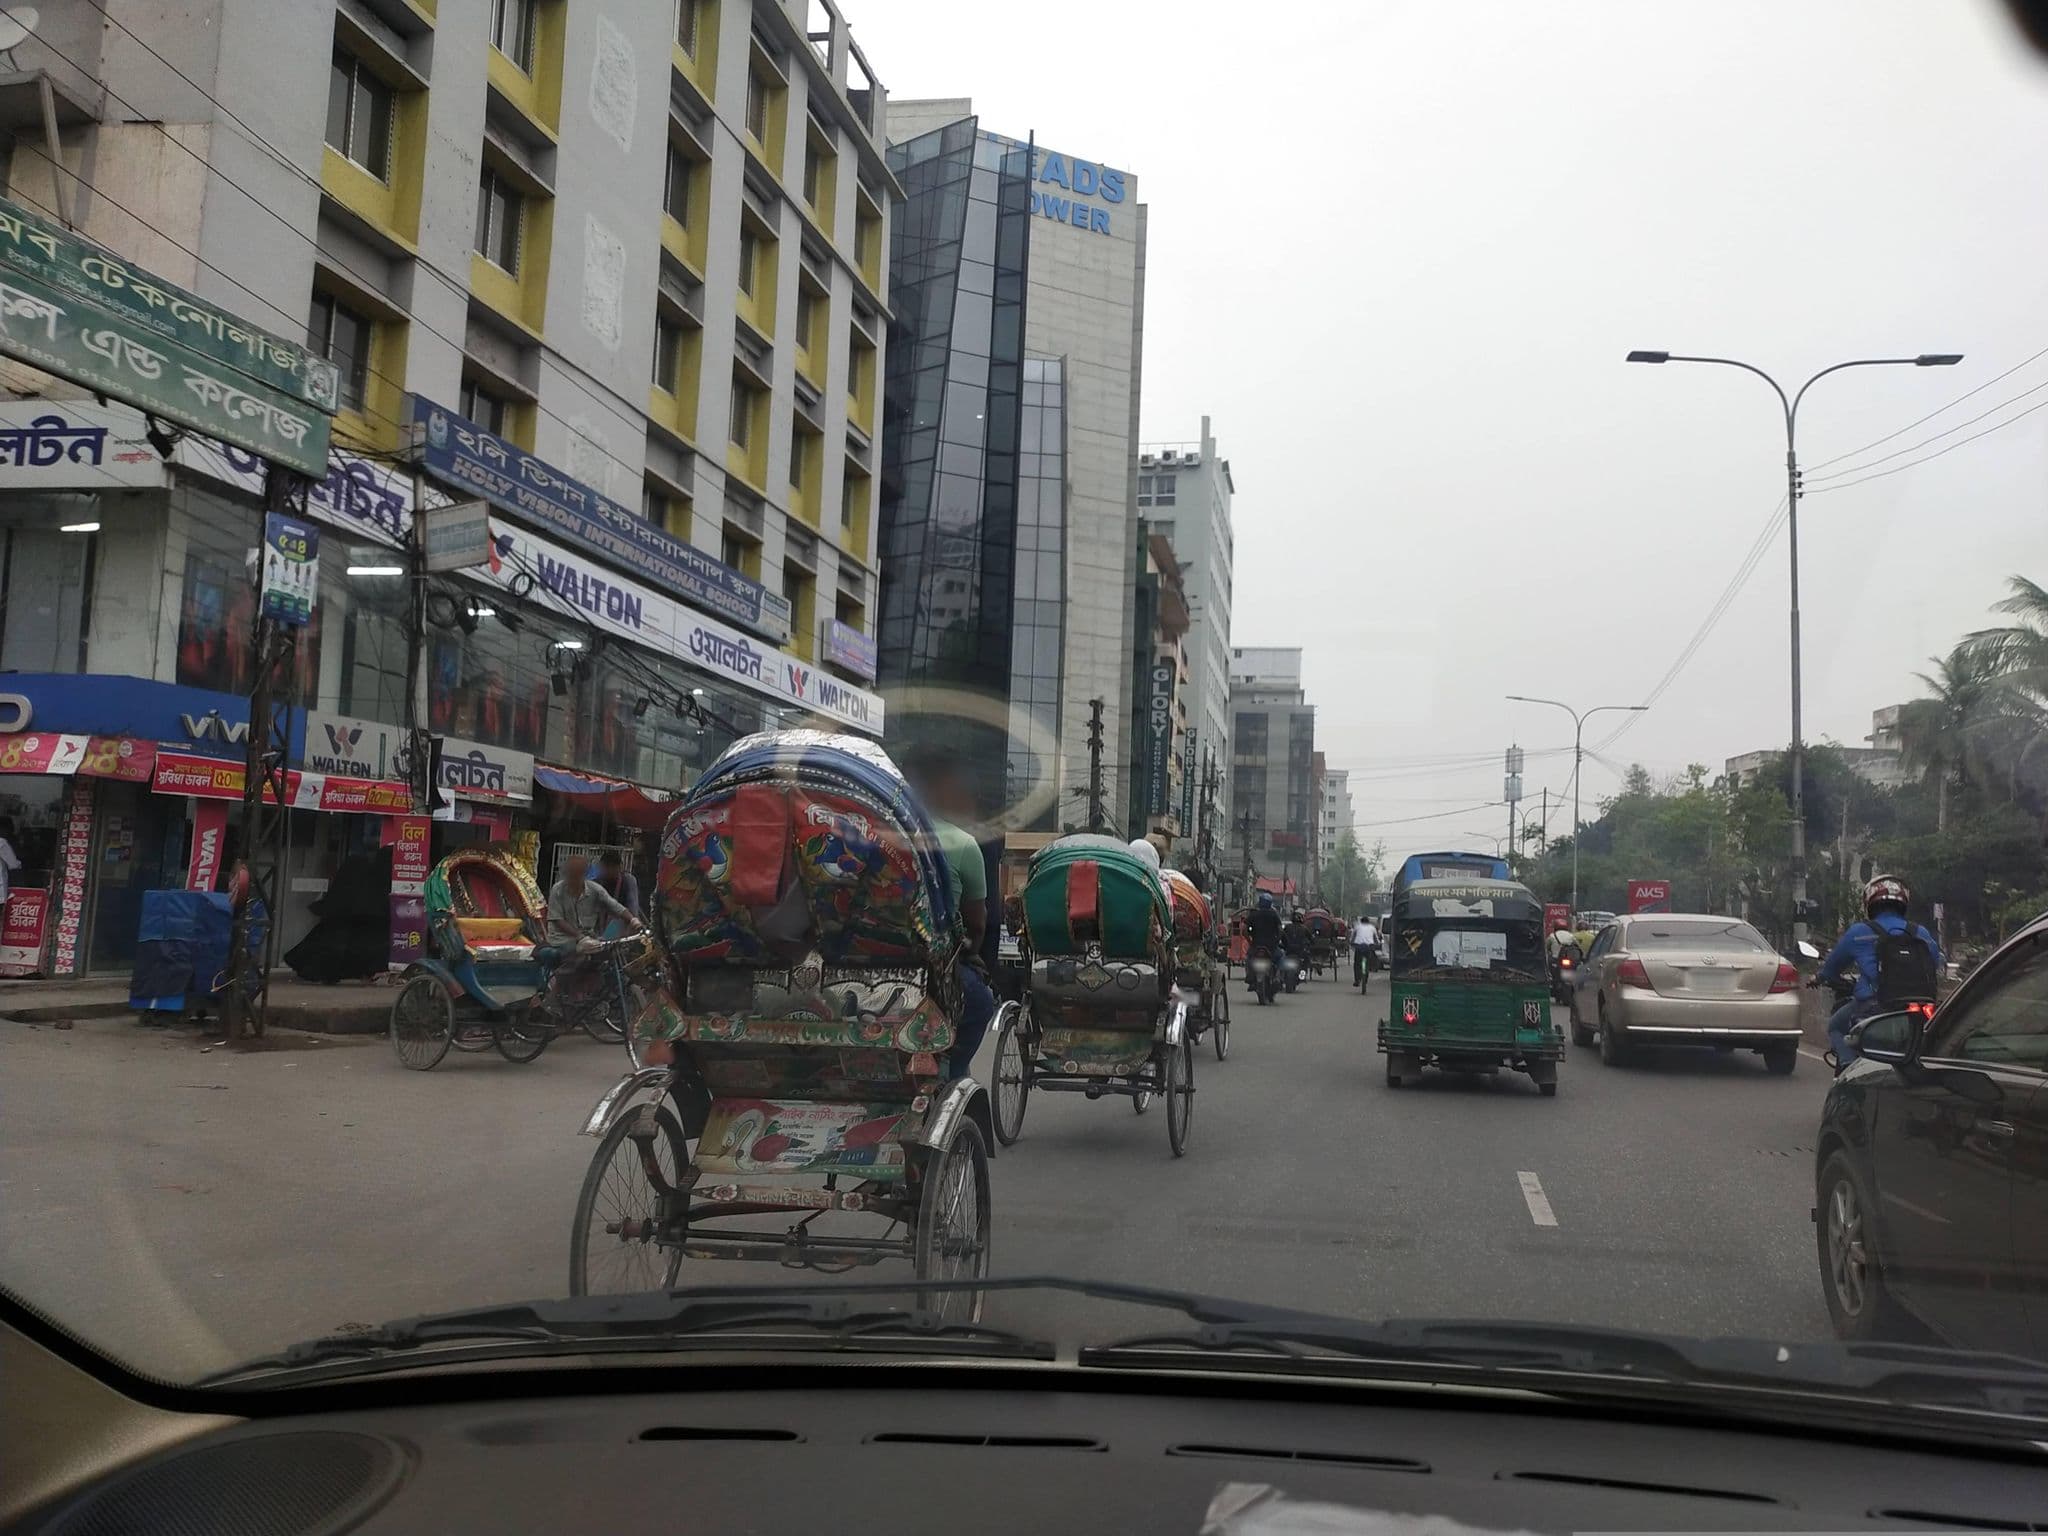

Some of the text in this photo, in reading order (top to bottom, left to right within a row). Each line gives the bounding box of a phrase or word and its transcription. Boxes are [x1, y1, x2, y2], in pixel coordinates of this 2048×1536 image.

[181, 363, 312, 449] কলেজ
[454, 425, 509, 469] হলি
[453, 457, 513, 497] HOLY
[517, 488, 582, 533] VISION
[585, 523, 701, 593] INTERNATIONAL
[706, 586, 755, 621] SCHOOL
[537, 552, 642, 629] WALTON
[819, 679, 869, 722] WALTON
[1151, 668, 1170, 738] GLORY
[180, 709, 252, 744] viv
[312, 755, 371, 777] WALTON
[1185, 729, 1196, 775] GLORY
[158, 769, 184, 787] সুবিধা
[185, 774, 211, 788] ডাবল
[402, 822, 426, 841] বিল
[11, 901, 40, 916] সুবিধা
[1635, 887, 1664, 898] AKS
[10, 915, 38, 928] ডাবল
